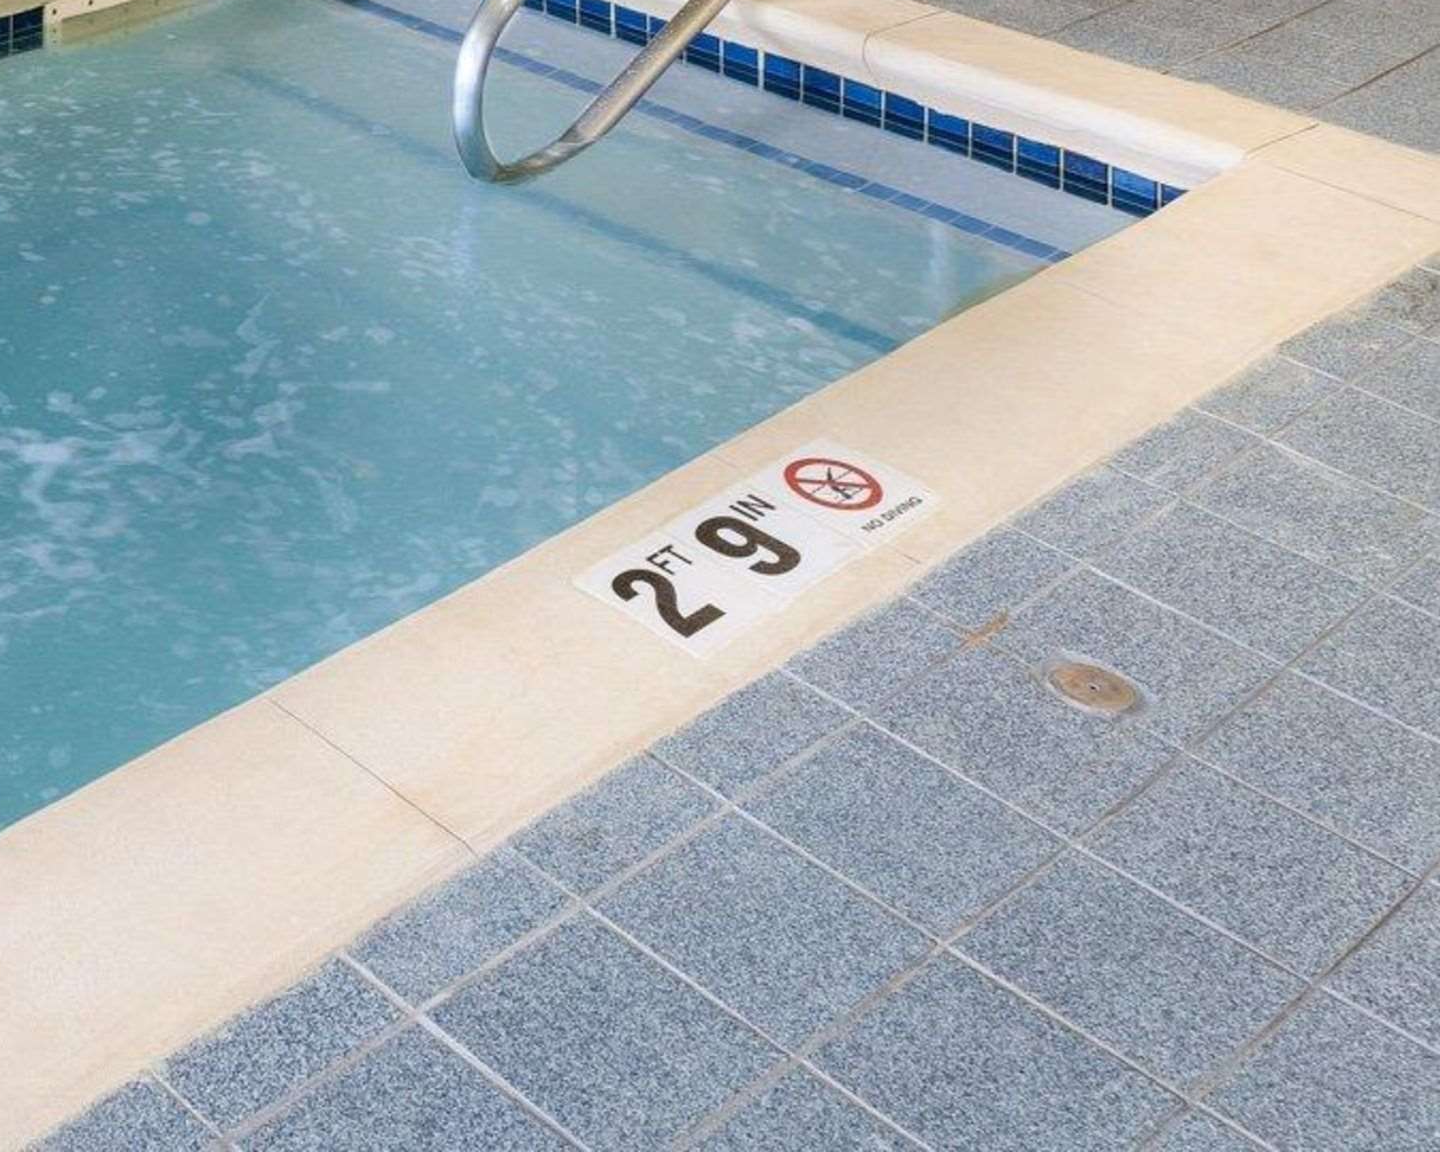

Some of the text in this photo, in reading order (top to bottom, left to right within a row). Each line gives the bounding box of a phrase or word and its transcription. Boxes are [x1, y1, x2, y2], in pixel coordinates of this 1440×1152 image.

[861, 496, 923, 533] NO DIVING
[611, 494, 801, 638] 2 FT 9 IN
